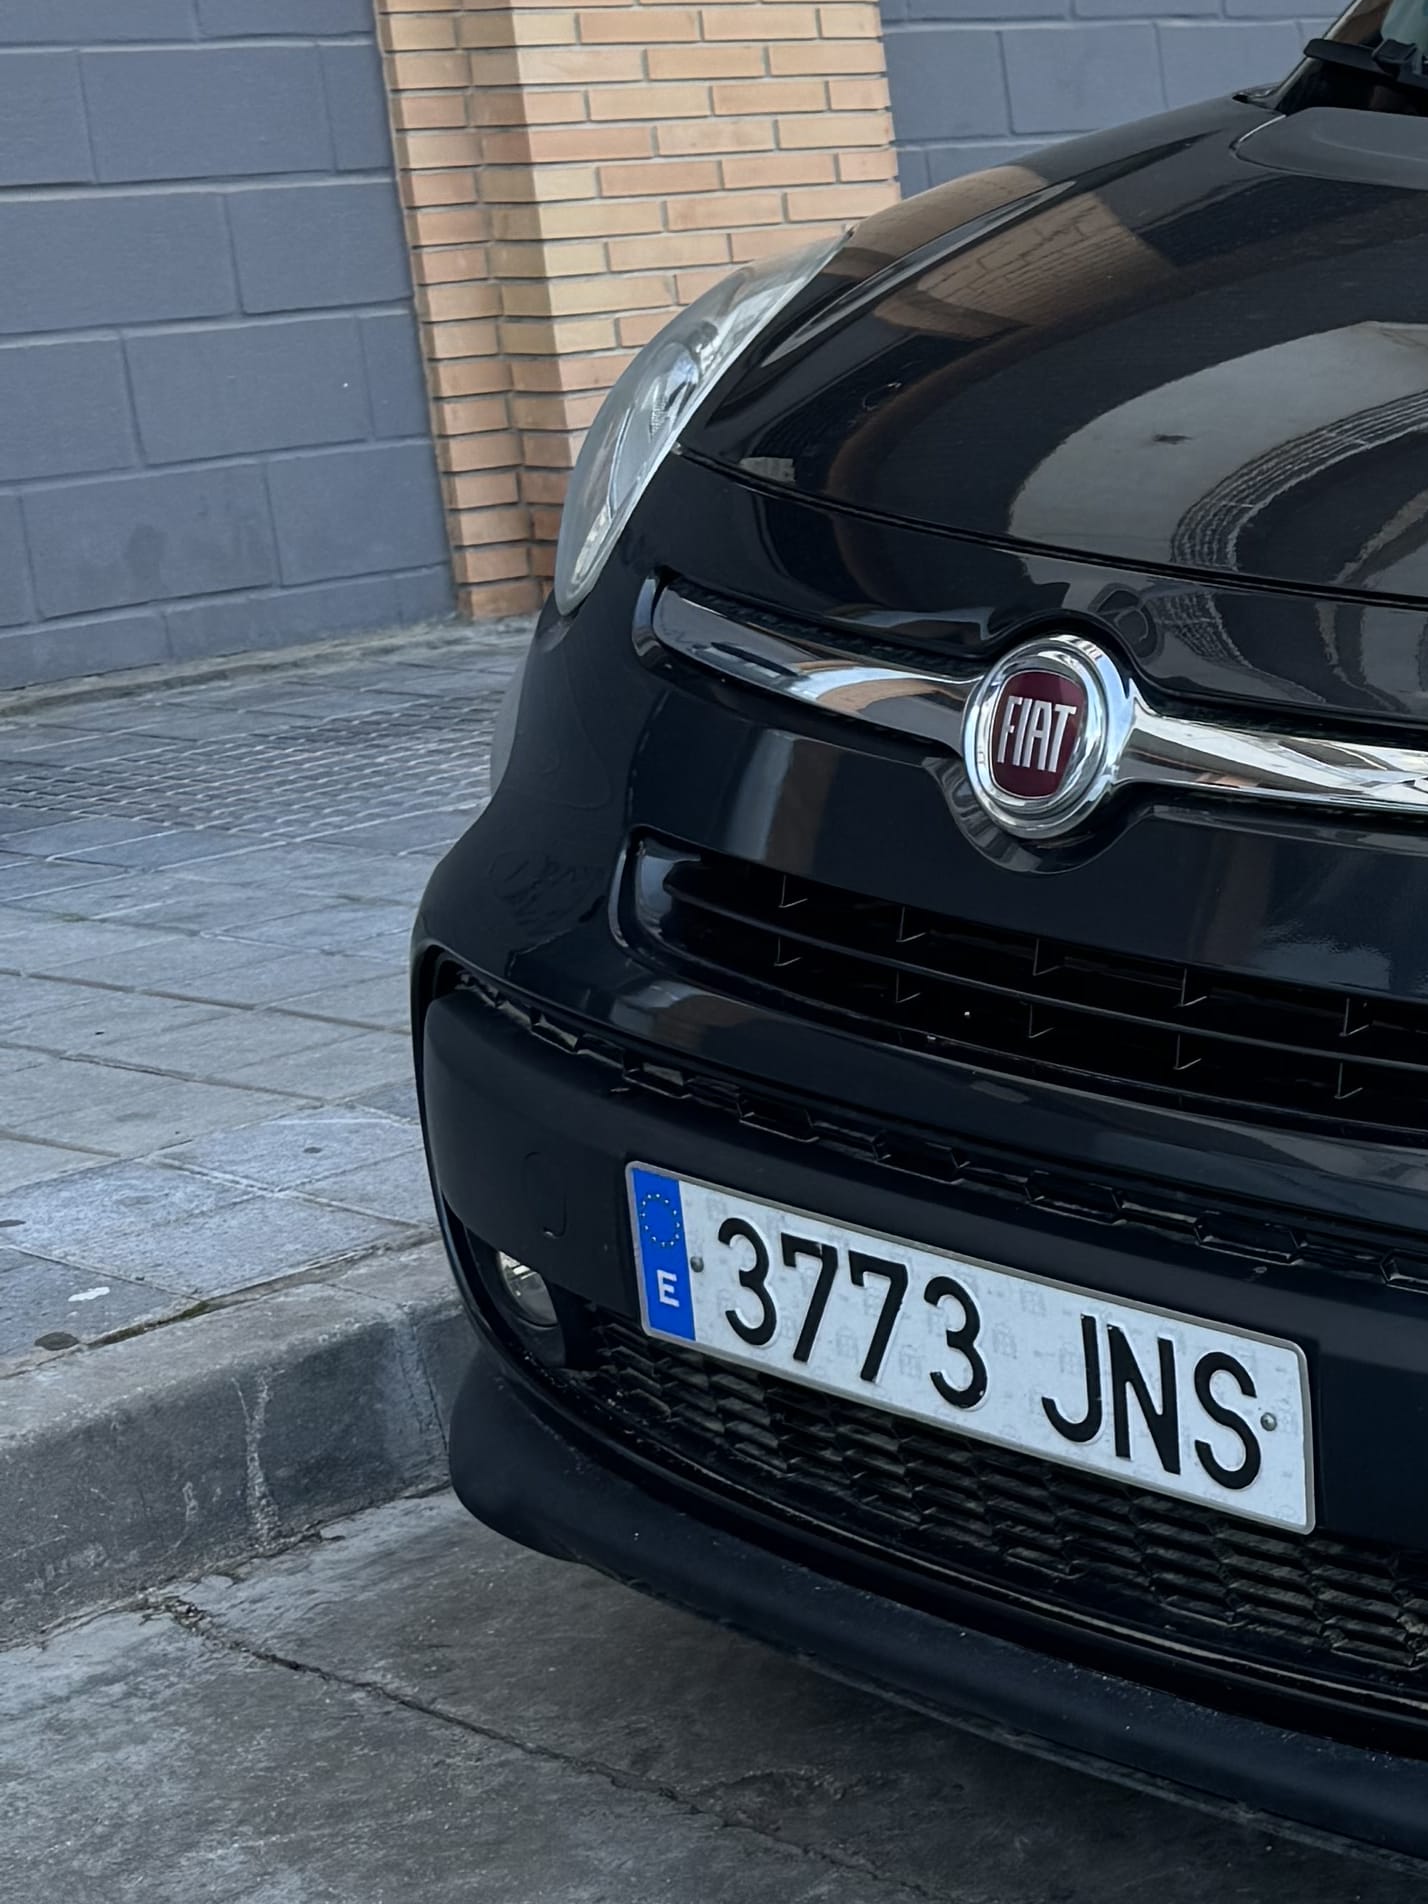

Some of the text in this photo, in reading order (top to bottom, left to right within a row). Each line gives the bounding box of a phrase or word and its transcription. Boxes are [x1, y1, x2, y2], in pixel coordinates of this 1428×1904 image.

[997, 695, 1077, 773] FIAT
[656, 1269, 680, 1308] E
[717, 1217, 1262, 1490] 3773 JNS
